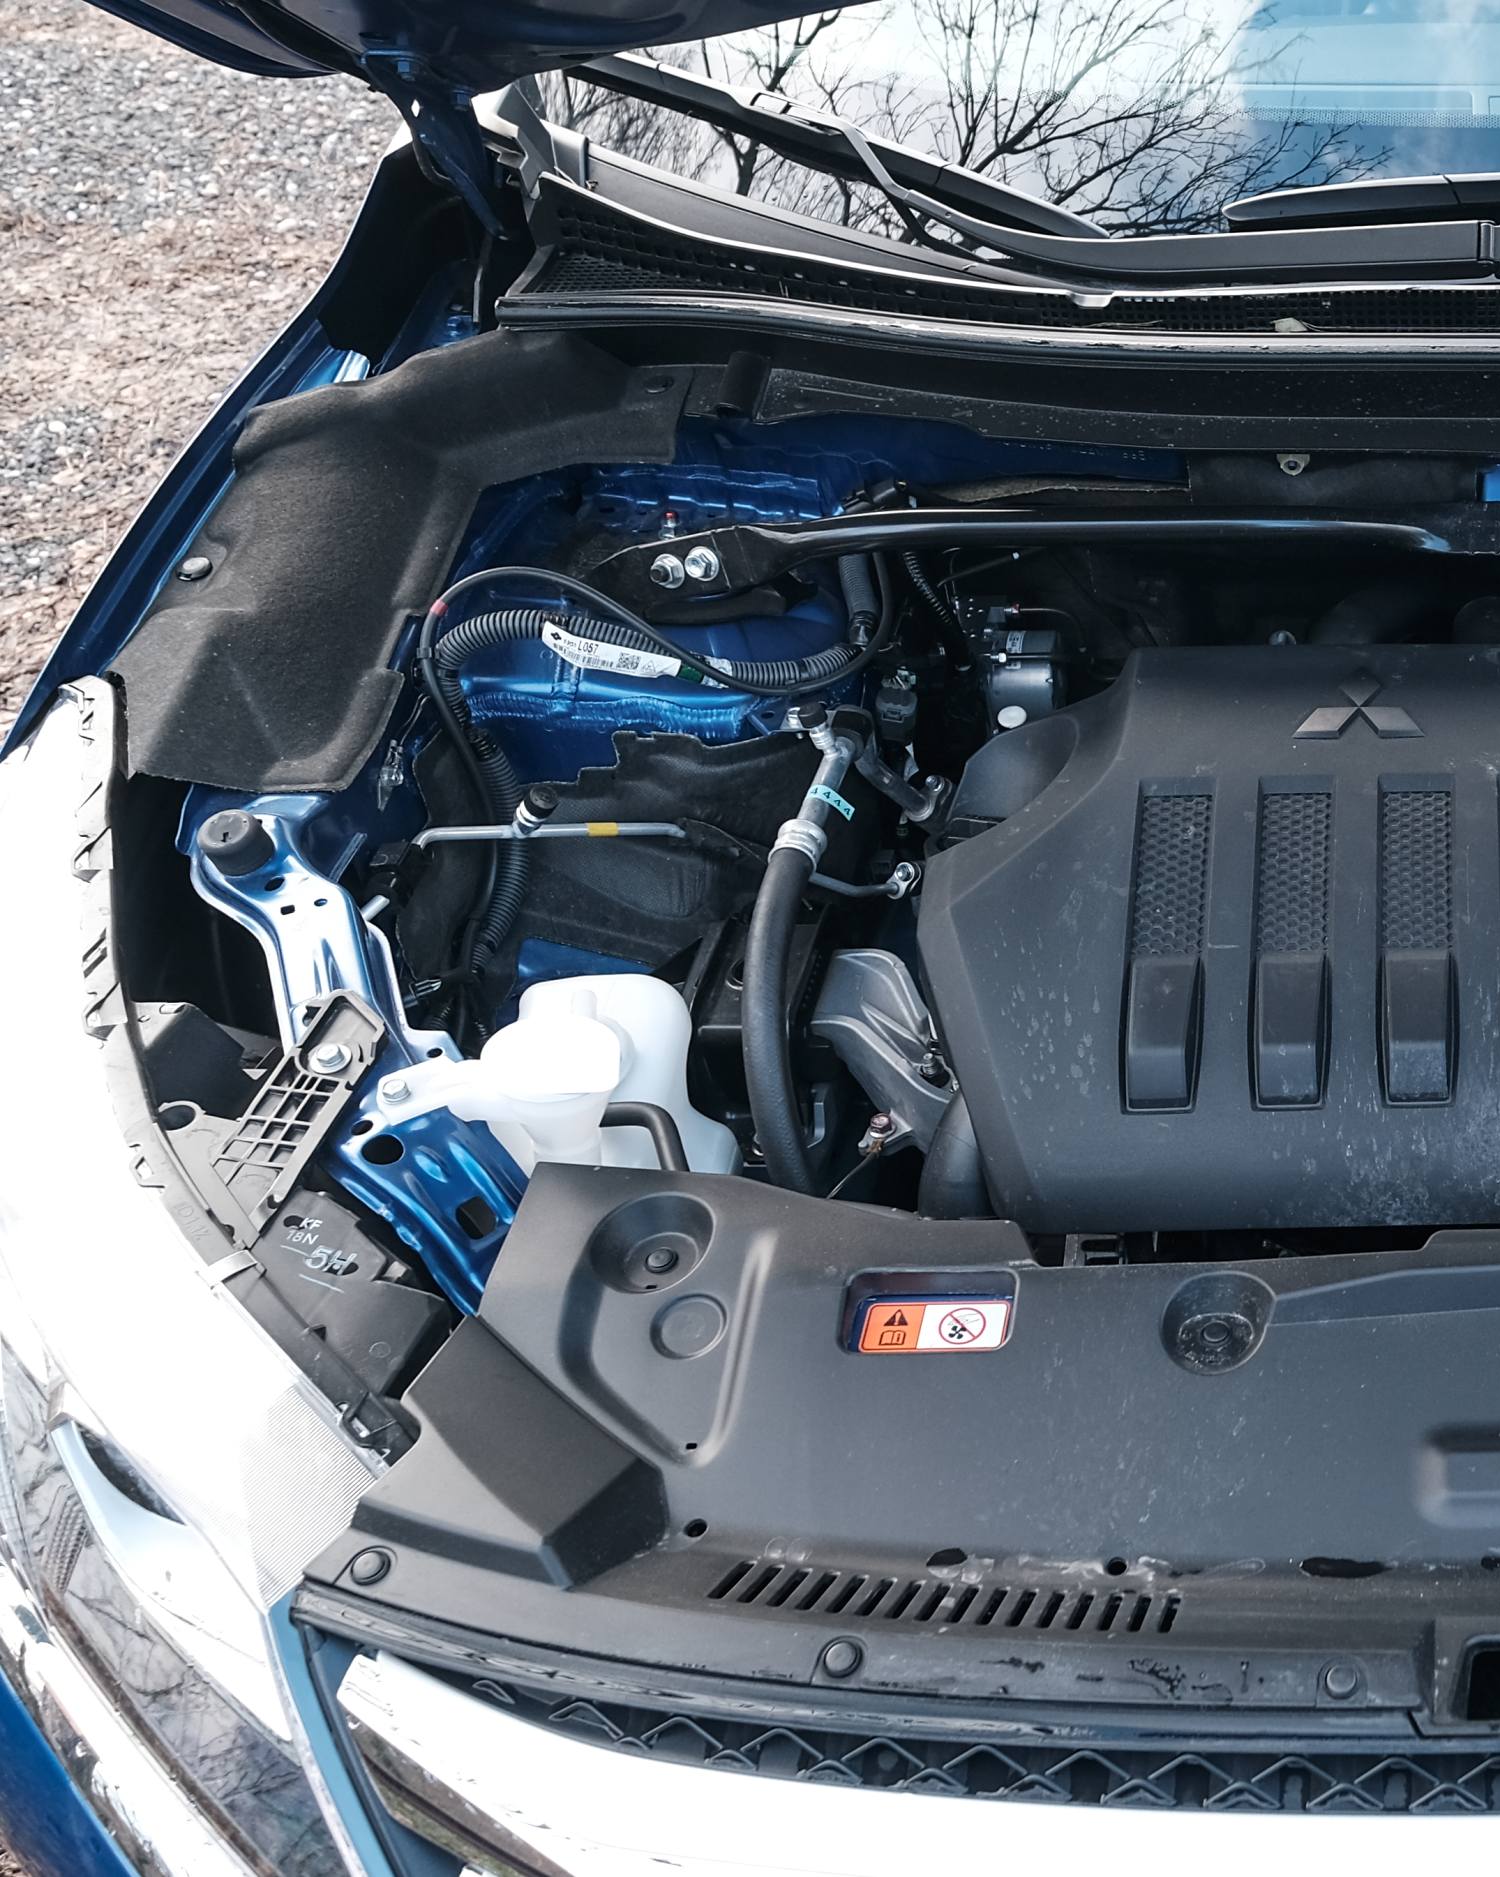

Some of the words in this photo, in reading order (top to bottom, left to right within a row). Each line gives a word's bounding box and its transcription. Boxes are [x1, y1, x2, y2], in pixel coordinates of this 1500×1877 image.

[577, 640, 599, 655] L057
[300, 1217, 323, 1229] KF
[286, 1230, 319, 1245] 18N
[304, 1245, 358, 1275] 5H
